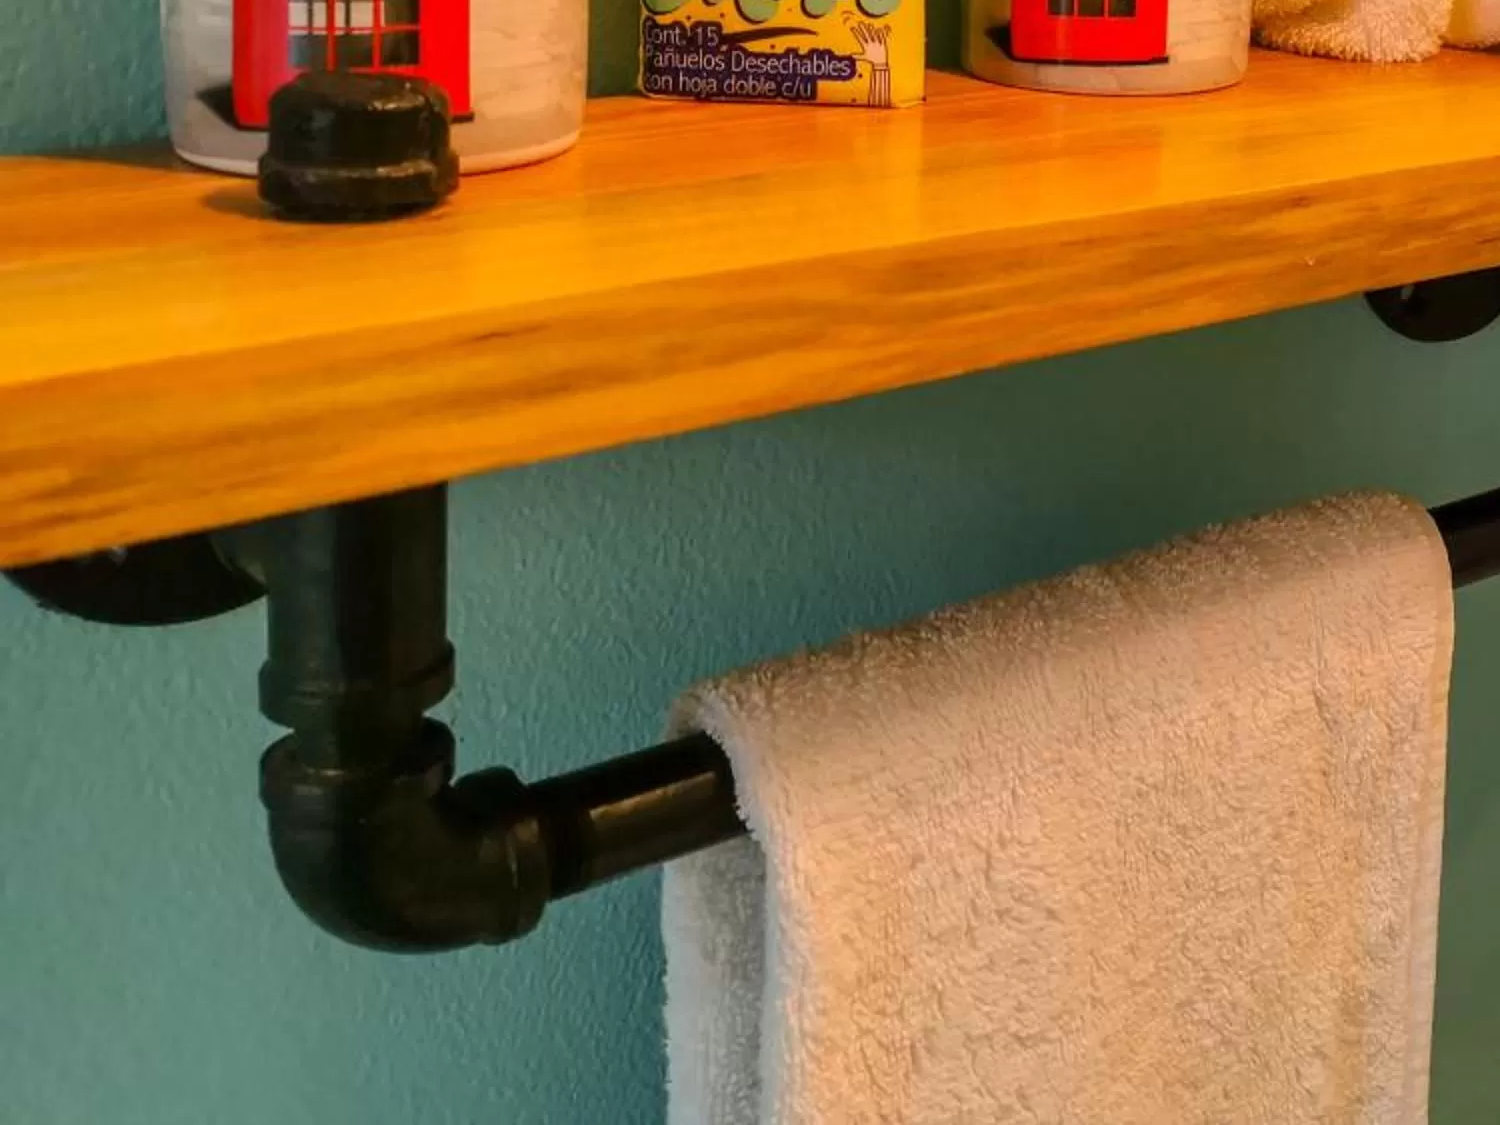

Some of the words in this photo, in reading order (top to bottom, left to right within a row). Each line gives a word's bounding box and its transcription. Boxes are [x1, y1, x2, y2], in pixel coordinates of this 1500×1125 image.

[695, 25, 719, 47] 15
[731, 50, 852, 77] Desechables
[679, 70, 717, 97] hoja
[723, 74, 777, 96] doble
[781, 77, 812, 97] c/u
